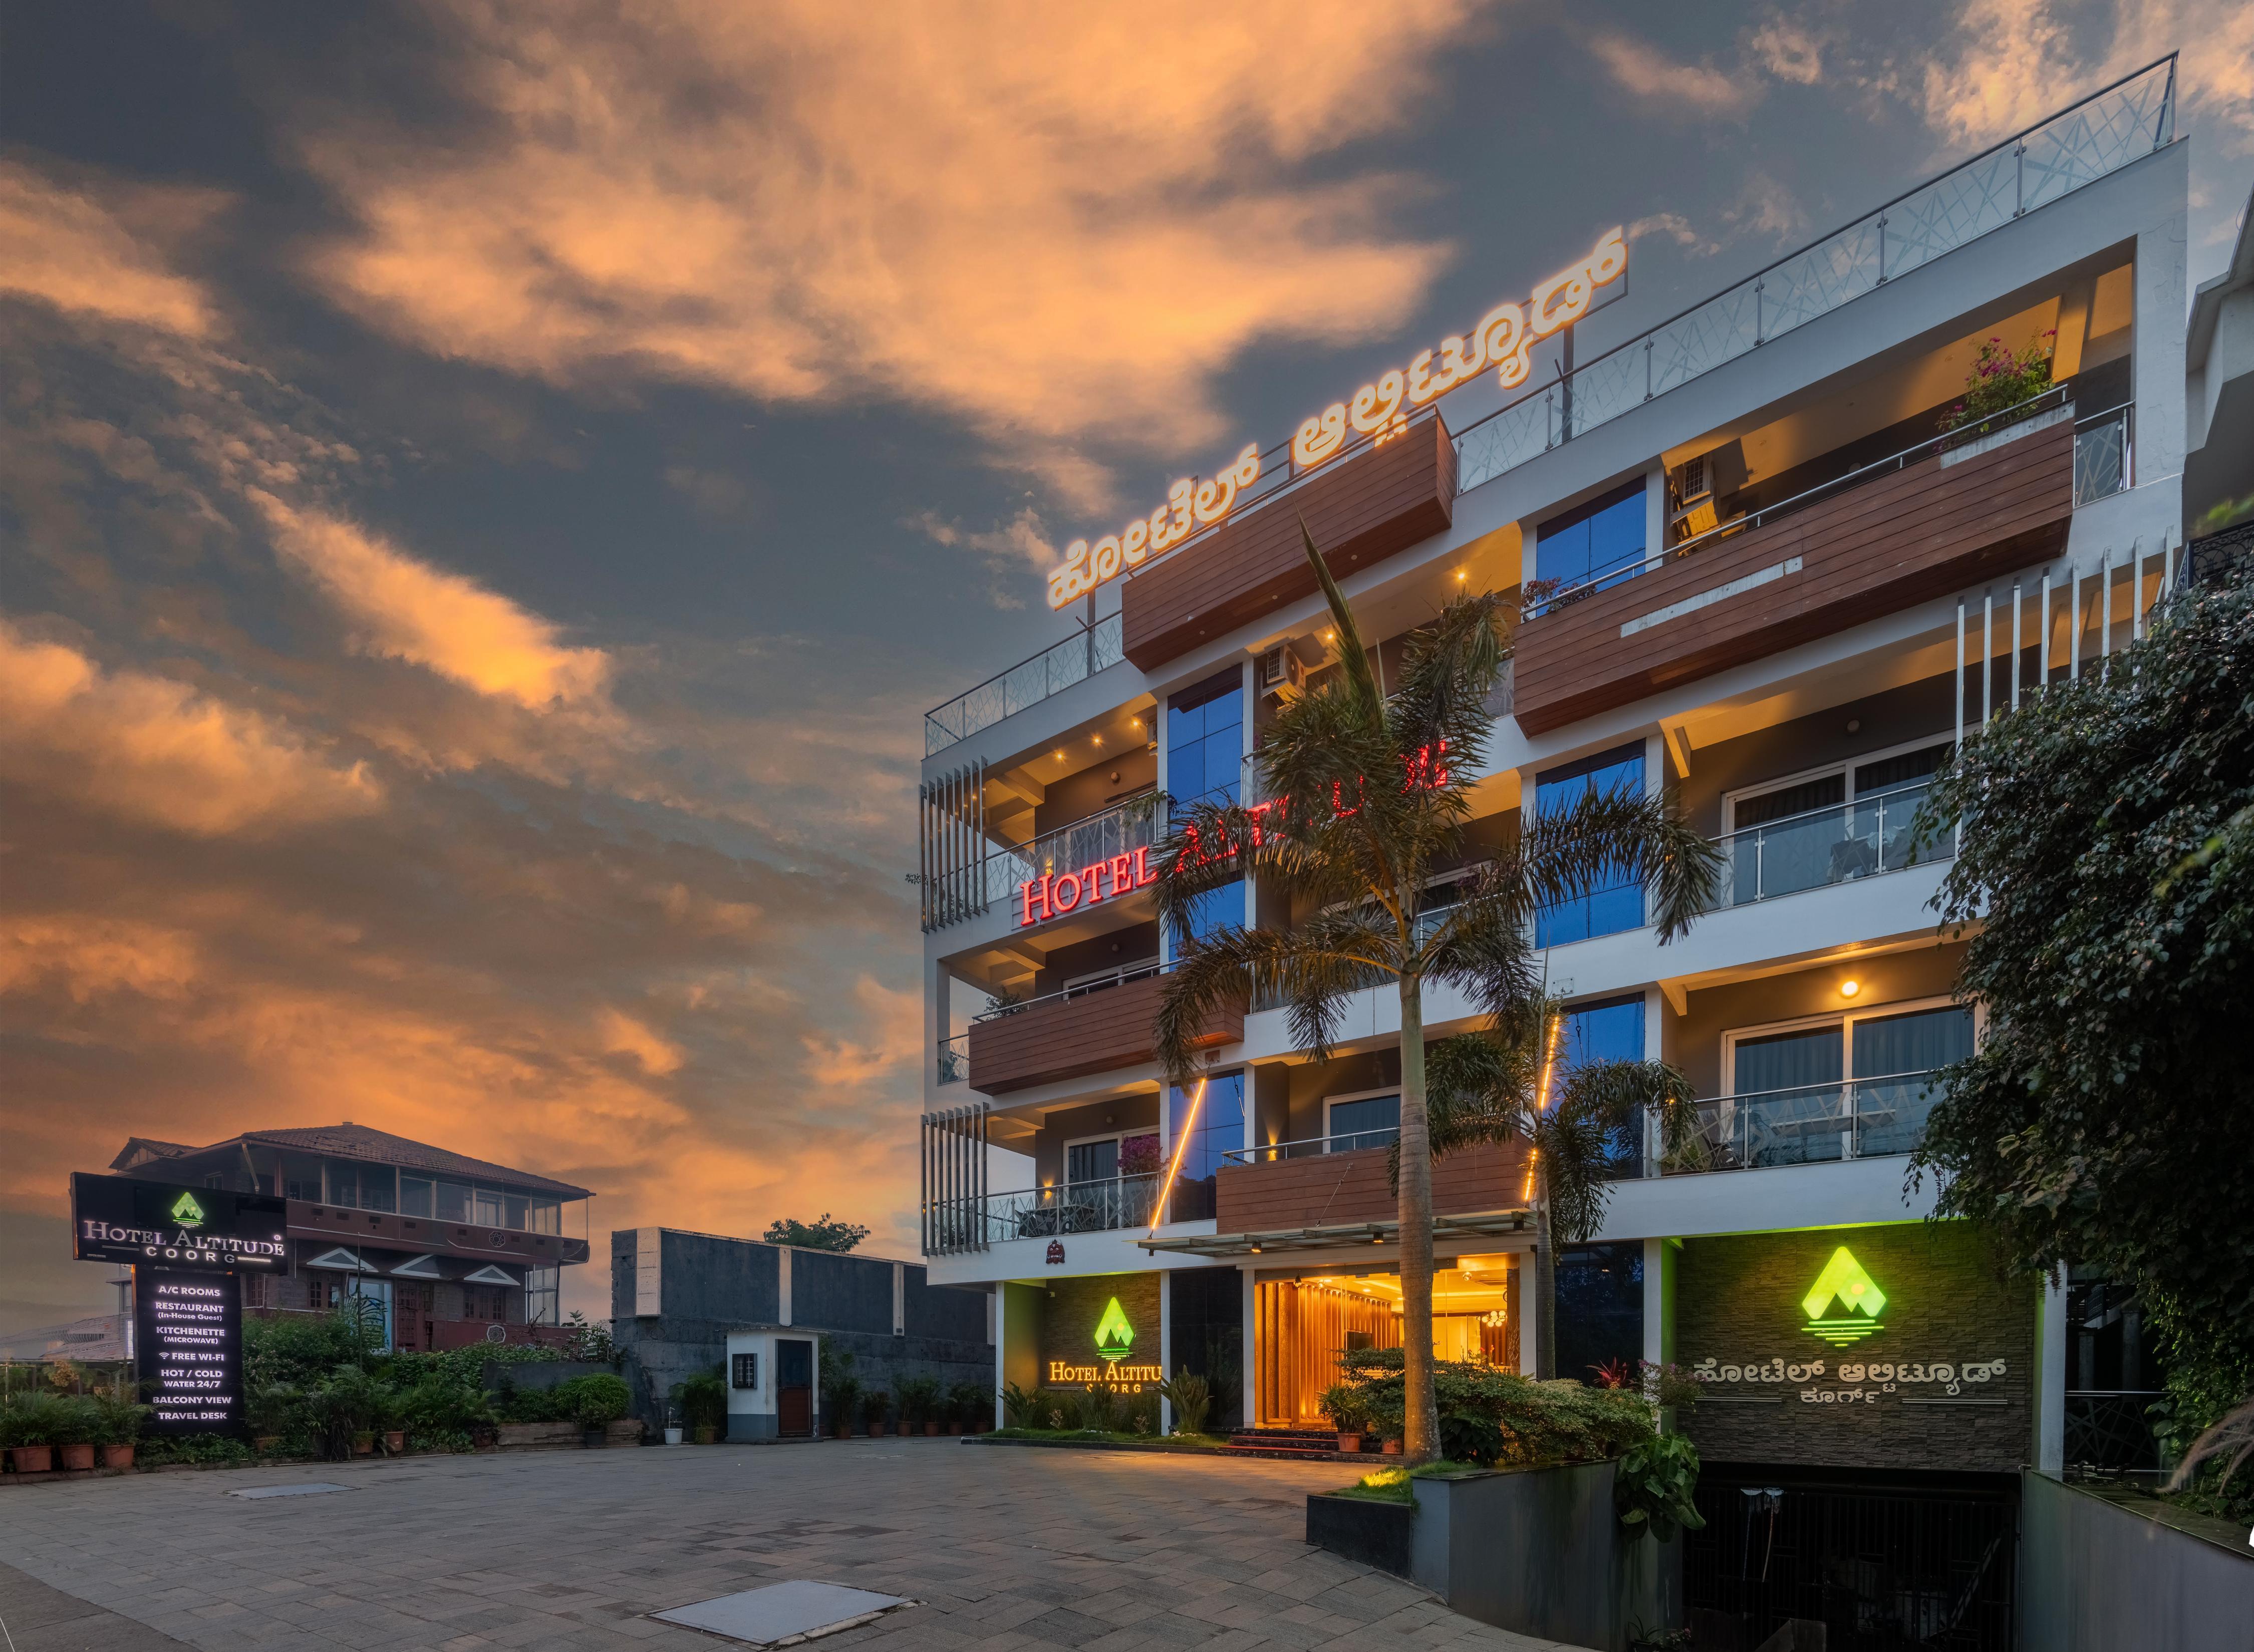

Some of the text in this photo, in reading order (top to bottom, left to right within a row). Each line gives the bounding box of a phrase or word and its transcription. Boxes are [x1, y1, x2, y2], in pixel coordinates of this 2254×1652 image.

[1020, 845, 1158, 926] HOTEL
[145, 1246, 235, 1264] COORG
[158, 1285, 221, 1296] A/C ROOMS
[155, 1301, 224, 1312] RESTAURANT
[156, 1327, 225, 1336] KITCHENETTE
[164, 1336, 218, 1345] (MICROWAVE)
[198, 1353, 224, 1361] WI-FI
[1105, 1361, 1162, 1381] ALTITU
[1694, 1358, 1825, 1383] ಹೋಟೆಲ್
[1086, 1383, 1141, 1393] CORG
